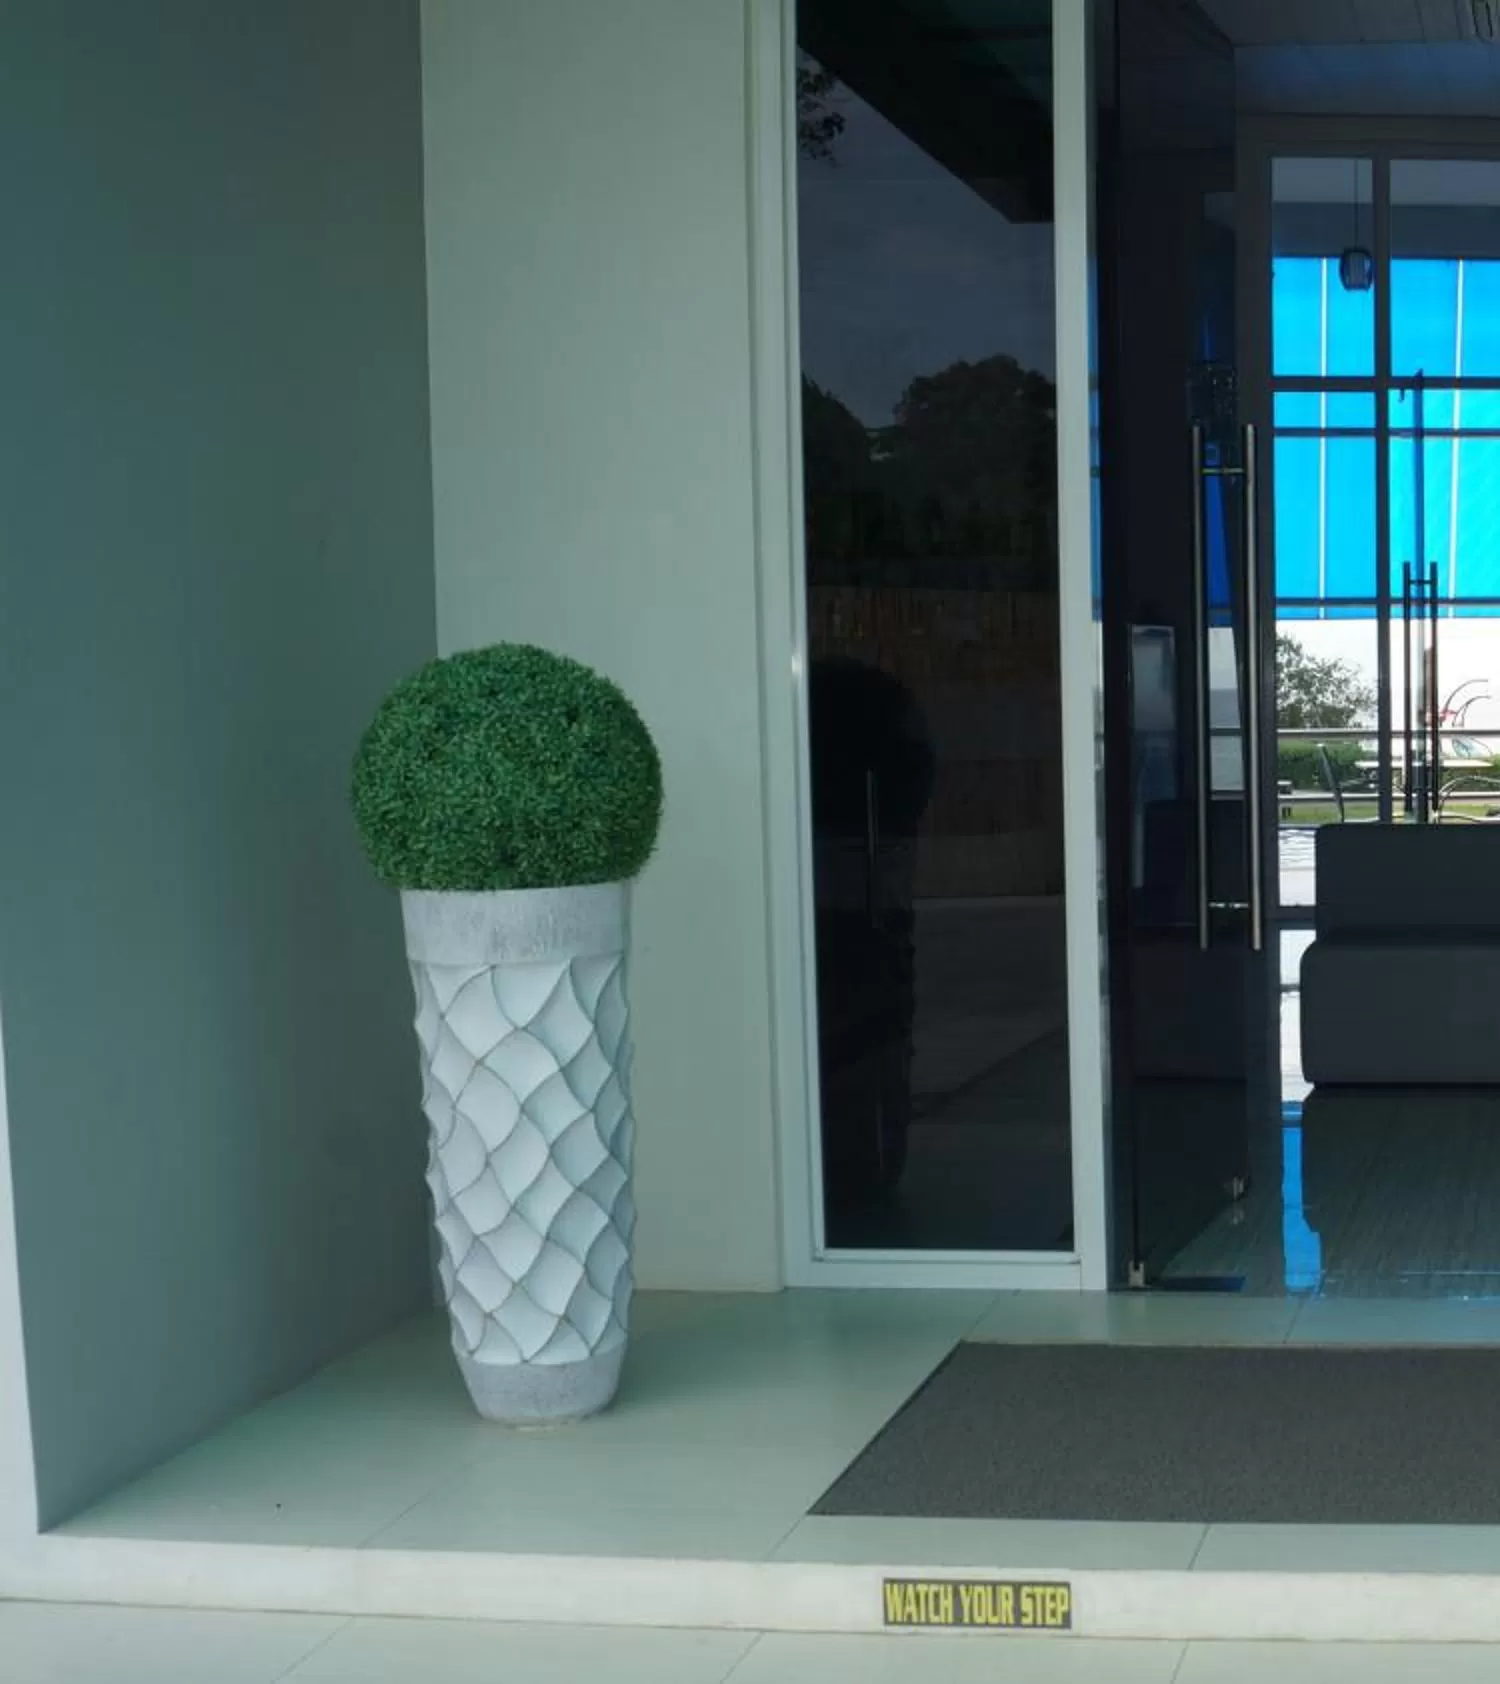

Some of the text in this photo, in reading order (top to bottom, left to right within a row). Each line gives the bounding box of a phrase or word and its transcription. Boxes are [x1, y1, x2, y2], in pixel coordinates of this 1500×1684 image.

[884, 1583, 1069, 1626] WATCH YOUR STEP
